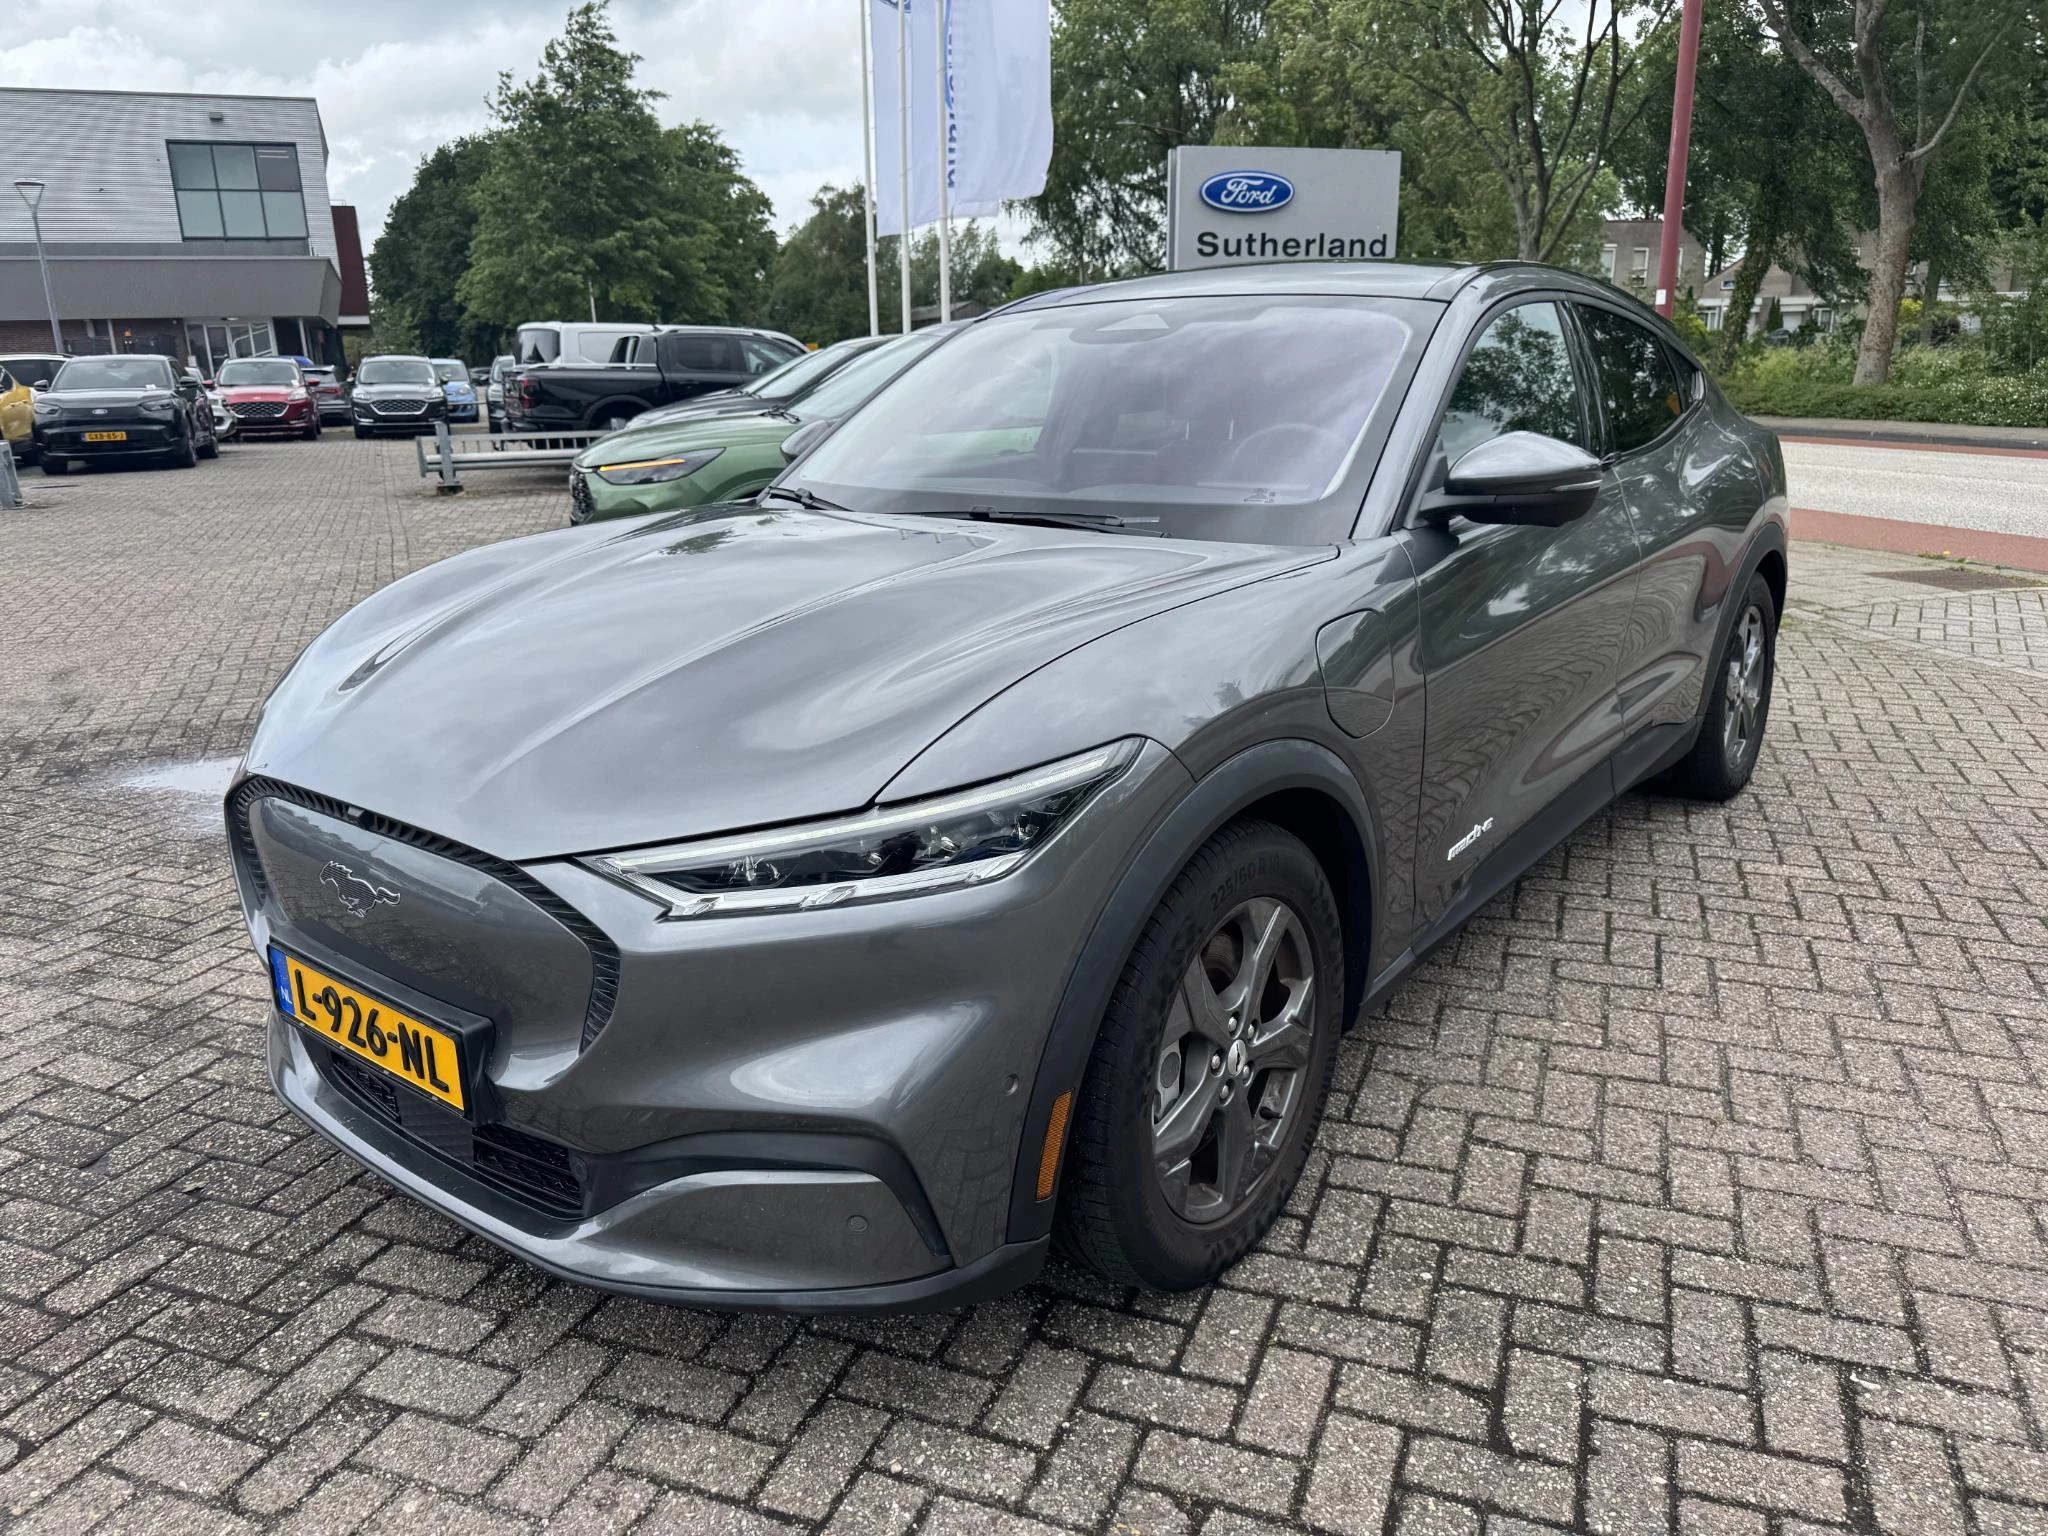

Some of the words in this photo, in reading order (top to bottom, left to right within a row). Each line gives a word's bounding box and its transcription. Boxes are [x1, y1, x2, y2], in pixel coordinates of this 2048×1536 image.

[1220, 178, 1278, 205] Ford
[1197, 231, 1388, 258] Sutherland
[280, 985, 293, 1005] NL
[294, 968, 450, 1093] L-926-NL
